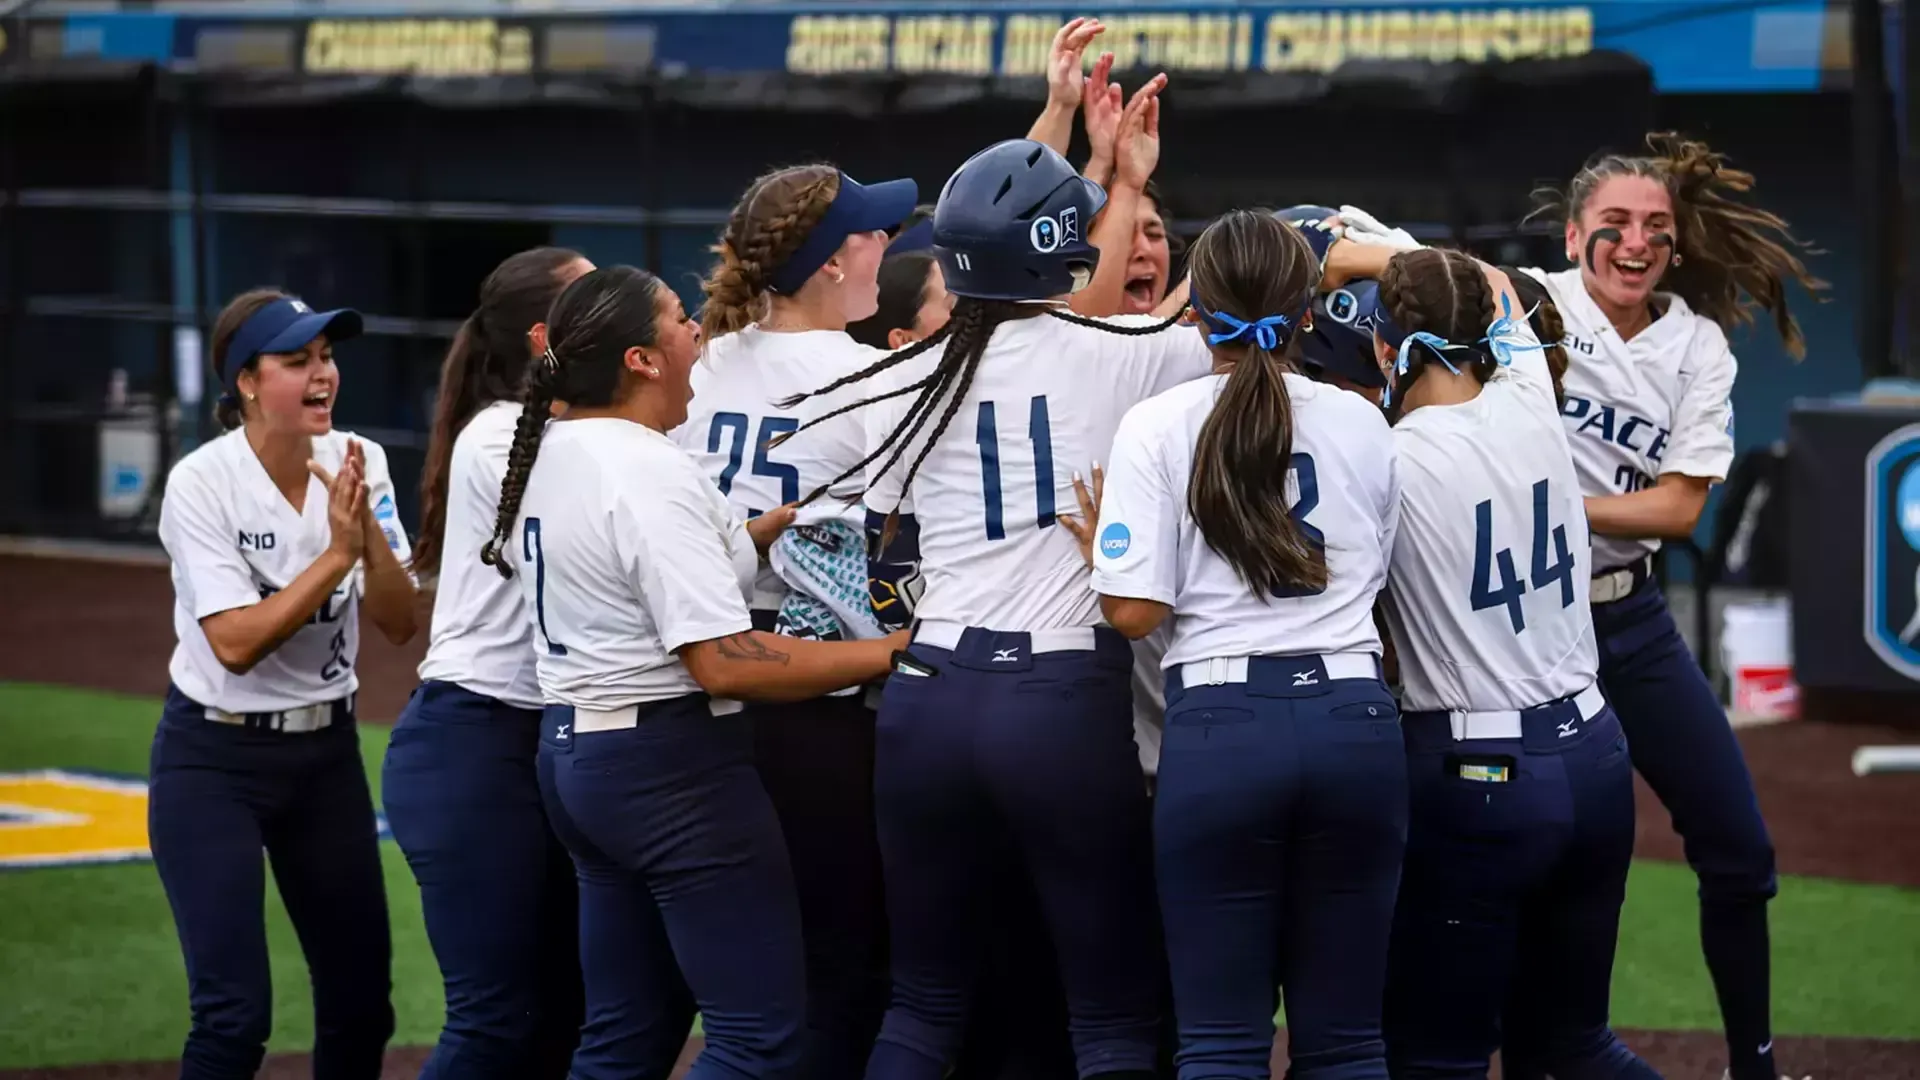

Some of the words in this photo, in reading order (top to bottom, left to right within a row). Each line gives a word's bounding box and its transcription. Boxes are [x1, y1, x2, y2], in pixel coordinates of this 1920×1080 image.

[955, 253, 971, 271] 11
[707, 411, 799, 519] 25
[976, 394, 1056, 541] 11
[1470, 478, 1575, 635] 44
